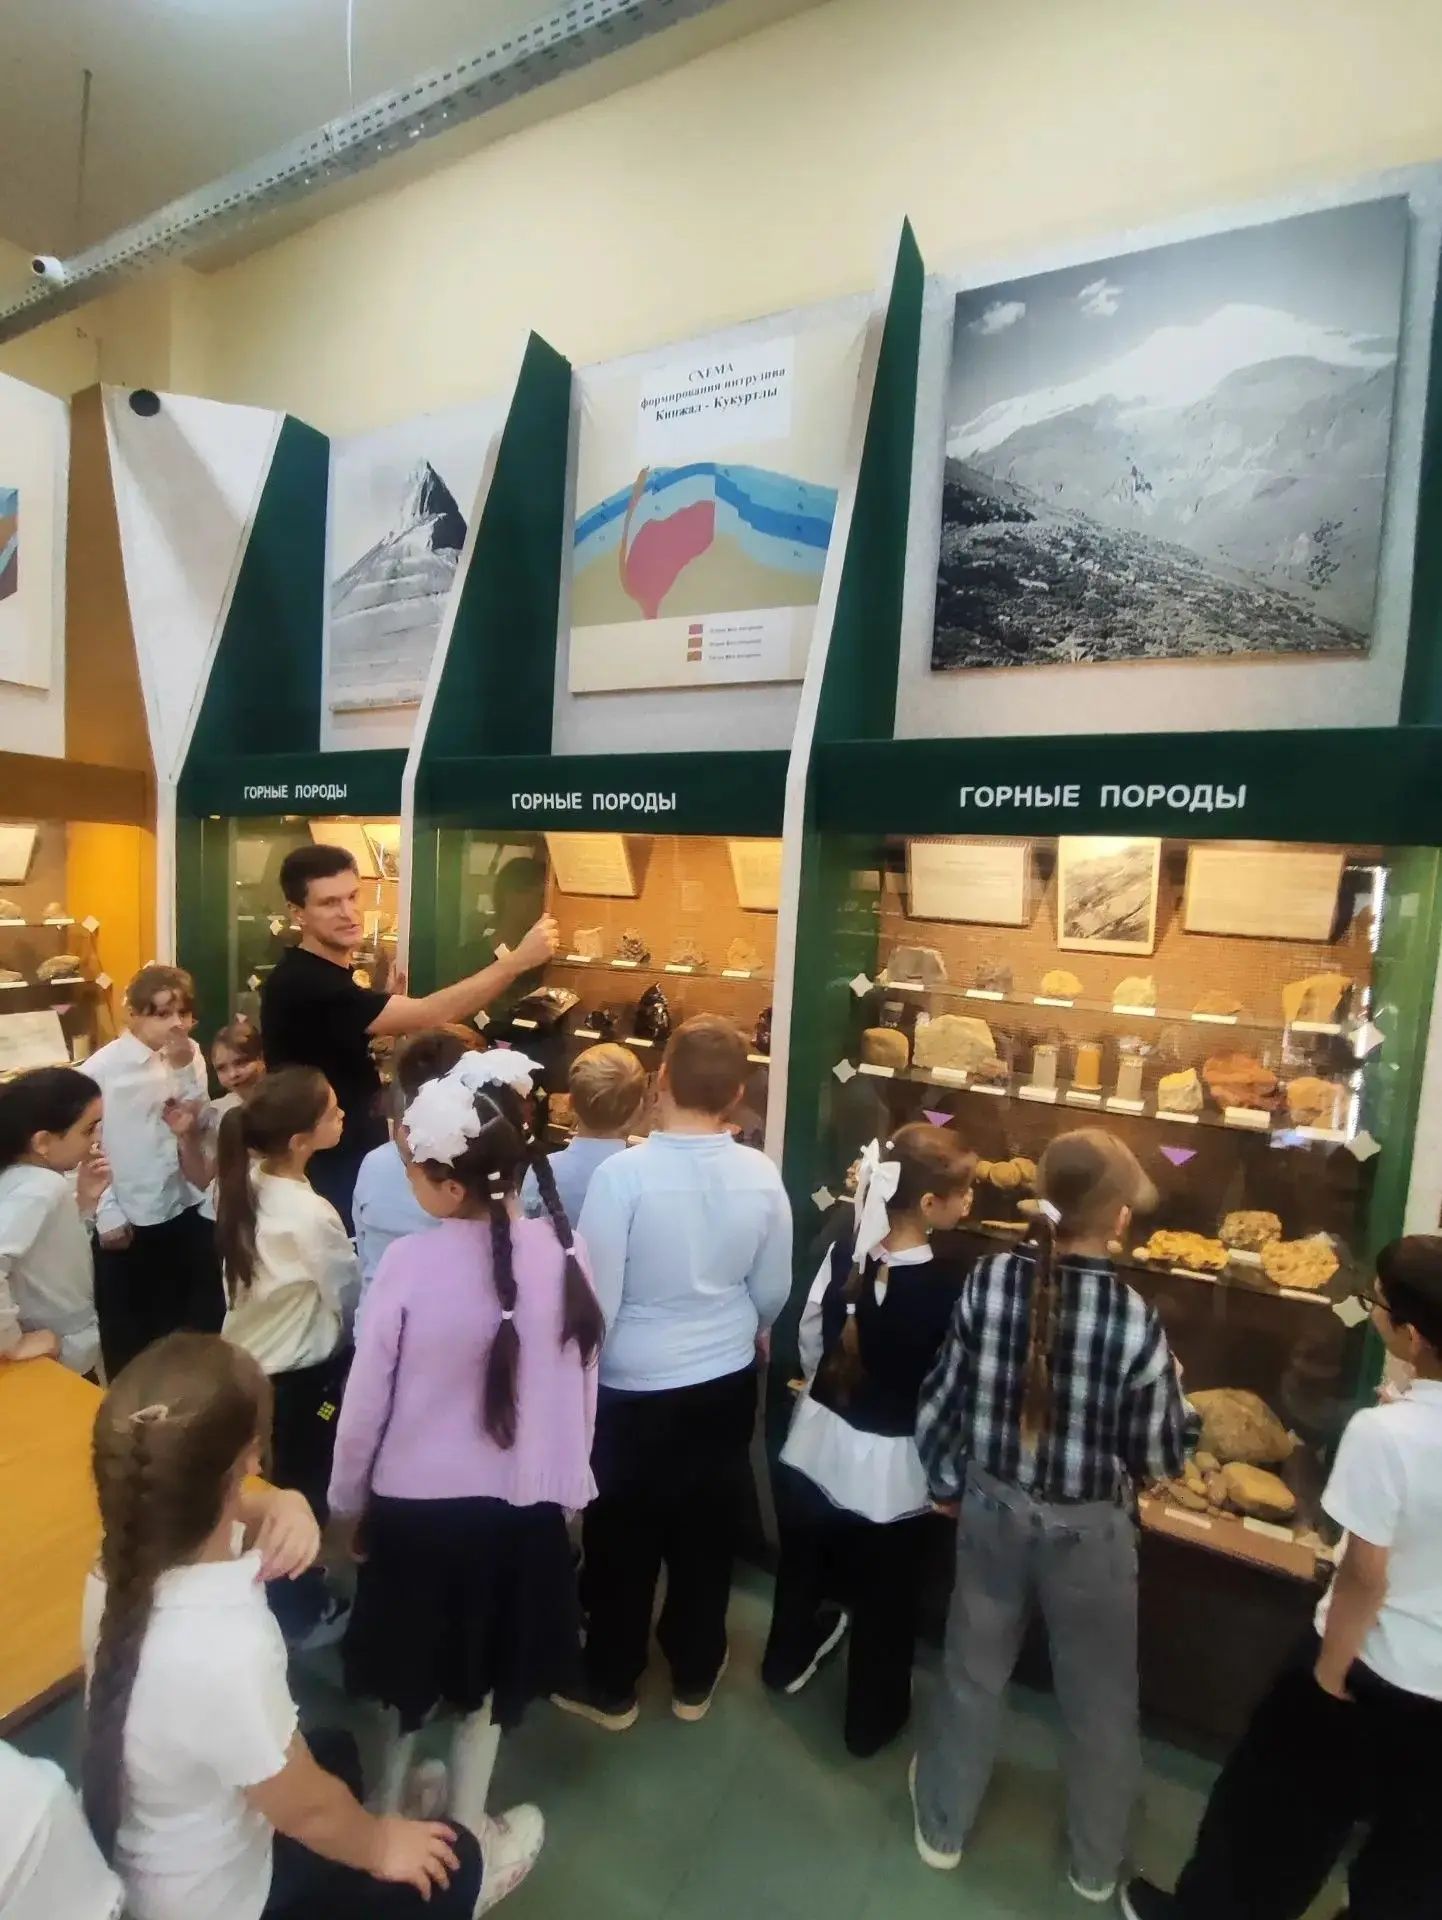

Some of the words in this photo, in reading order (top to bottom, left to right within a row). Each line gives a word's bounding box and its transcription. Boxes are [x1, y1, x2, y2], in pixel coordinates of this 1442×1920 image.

[688, 362, 734, 383] СХЕМА
[640, 384, 721, 411] формирования
[655, 404, 702, 422] Кинжал
[713, 387, 778, 412] Кукуртлы
[244, 785, 289, 799] ГОРНЫЕ
[294, 784, 348, 801] ПОРОДЫ
[512, 793, 583, 810] ГОРНЫЕ
[592, 792, 677, 813] ПОРОДЫ
[959, 784, 1081, 808] ГОРНЫЕ
[1099, 784, 1248, 813] ПОРОДЫ
